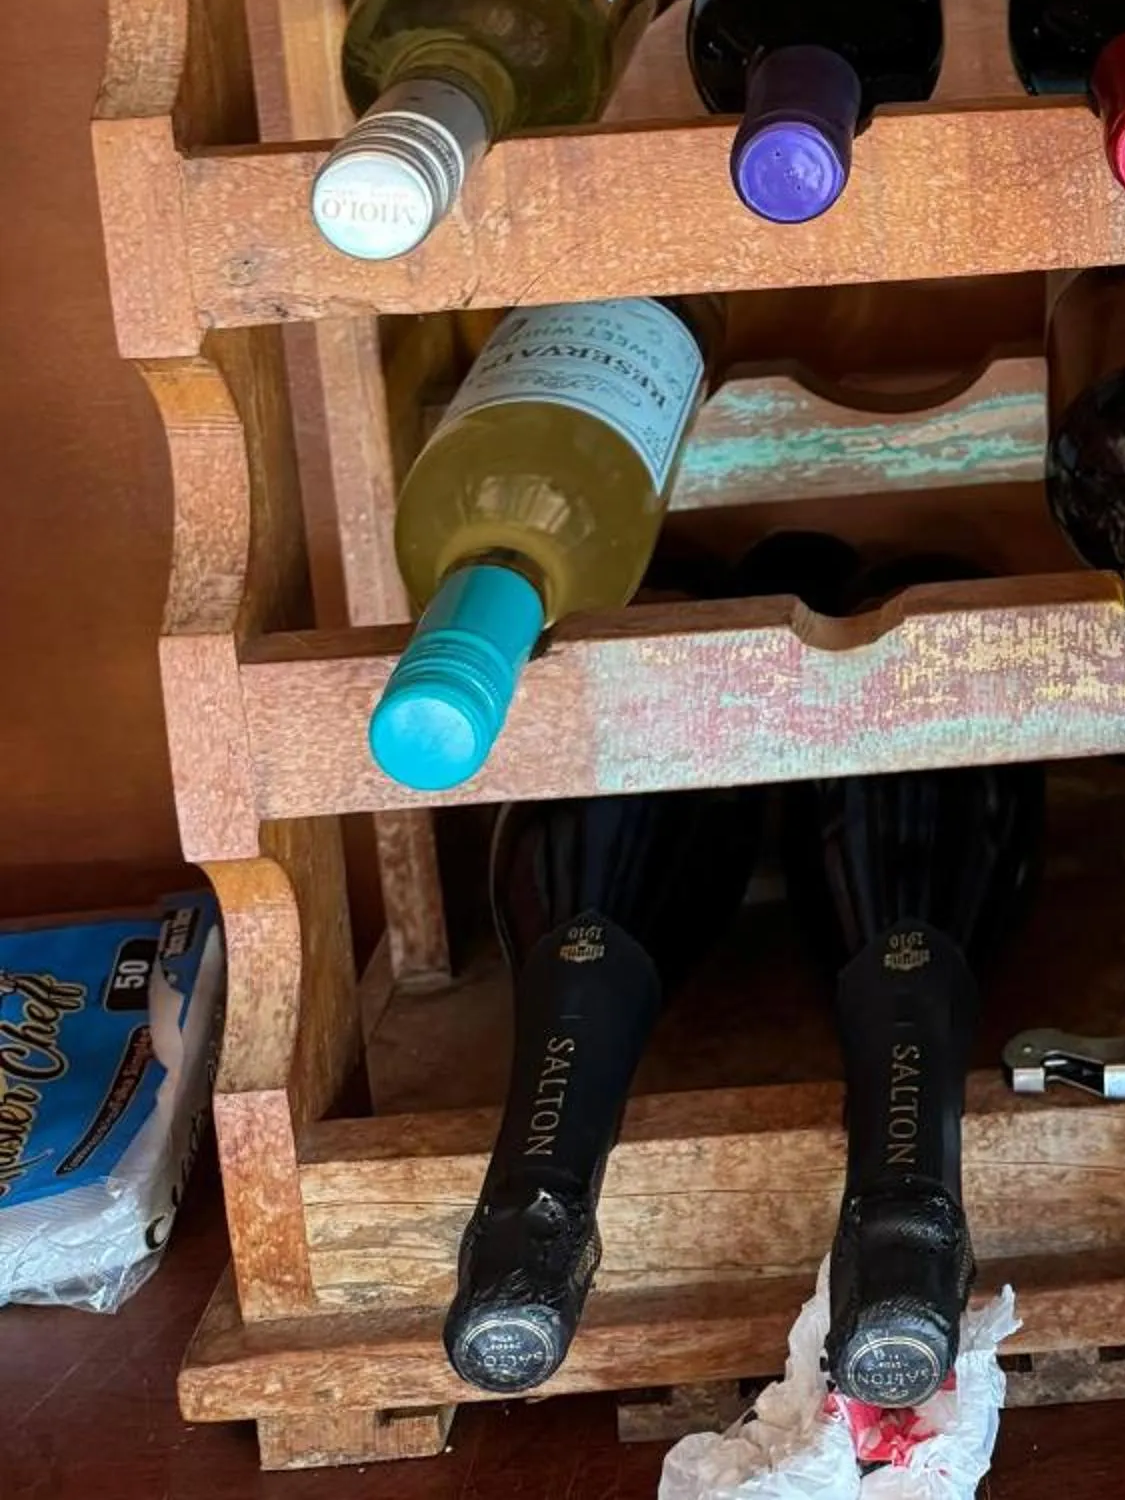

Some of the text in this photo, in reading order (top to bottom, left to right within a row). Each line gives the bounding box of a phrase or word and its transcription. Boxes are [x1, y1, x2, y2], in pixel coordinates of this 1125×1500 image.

[115, 958, 149, 991] 50
[524, 1036, 575, 1158] SALTON
[886, 1043, 922, 1166] SALTON
[857, 1367, 930, 1387] SALTON
